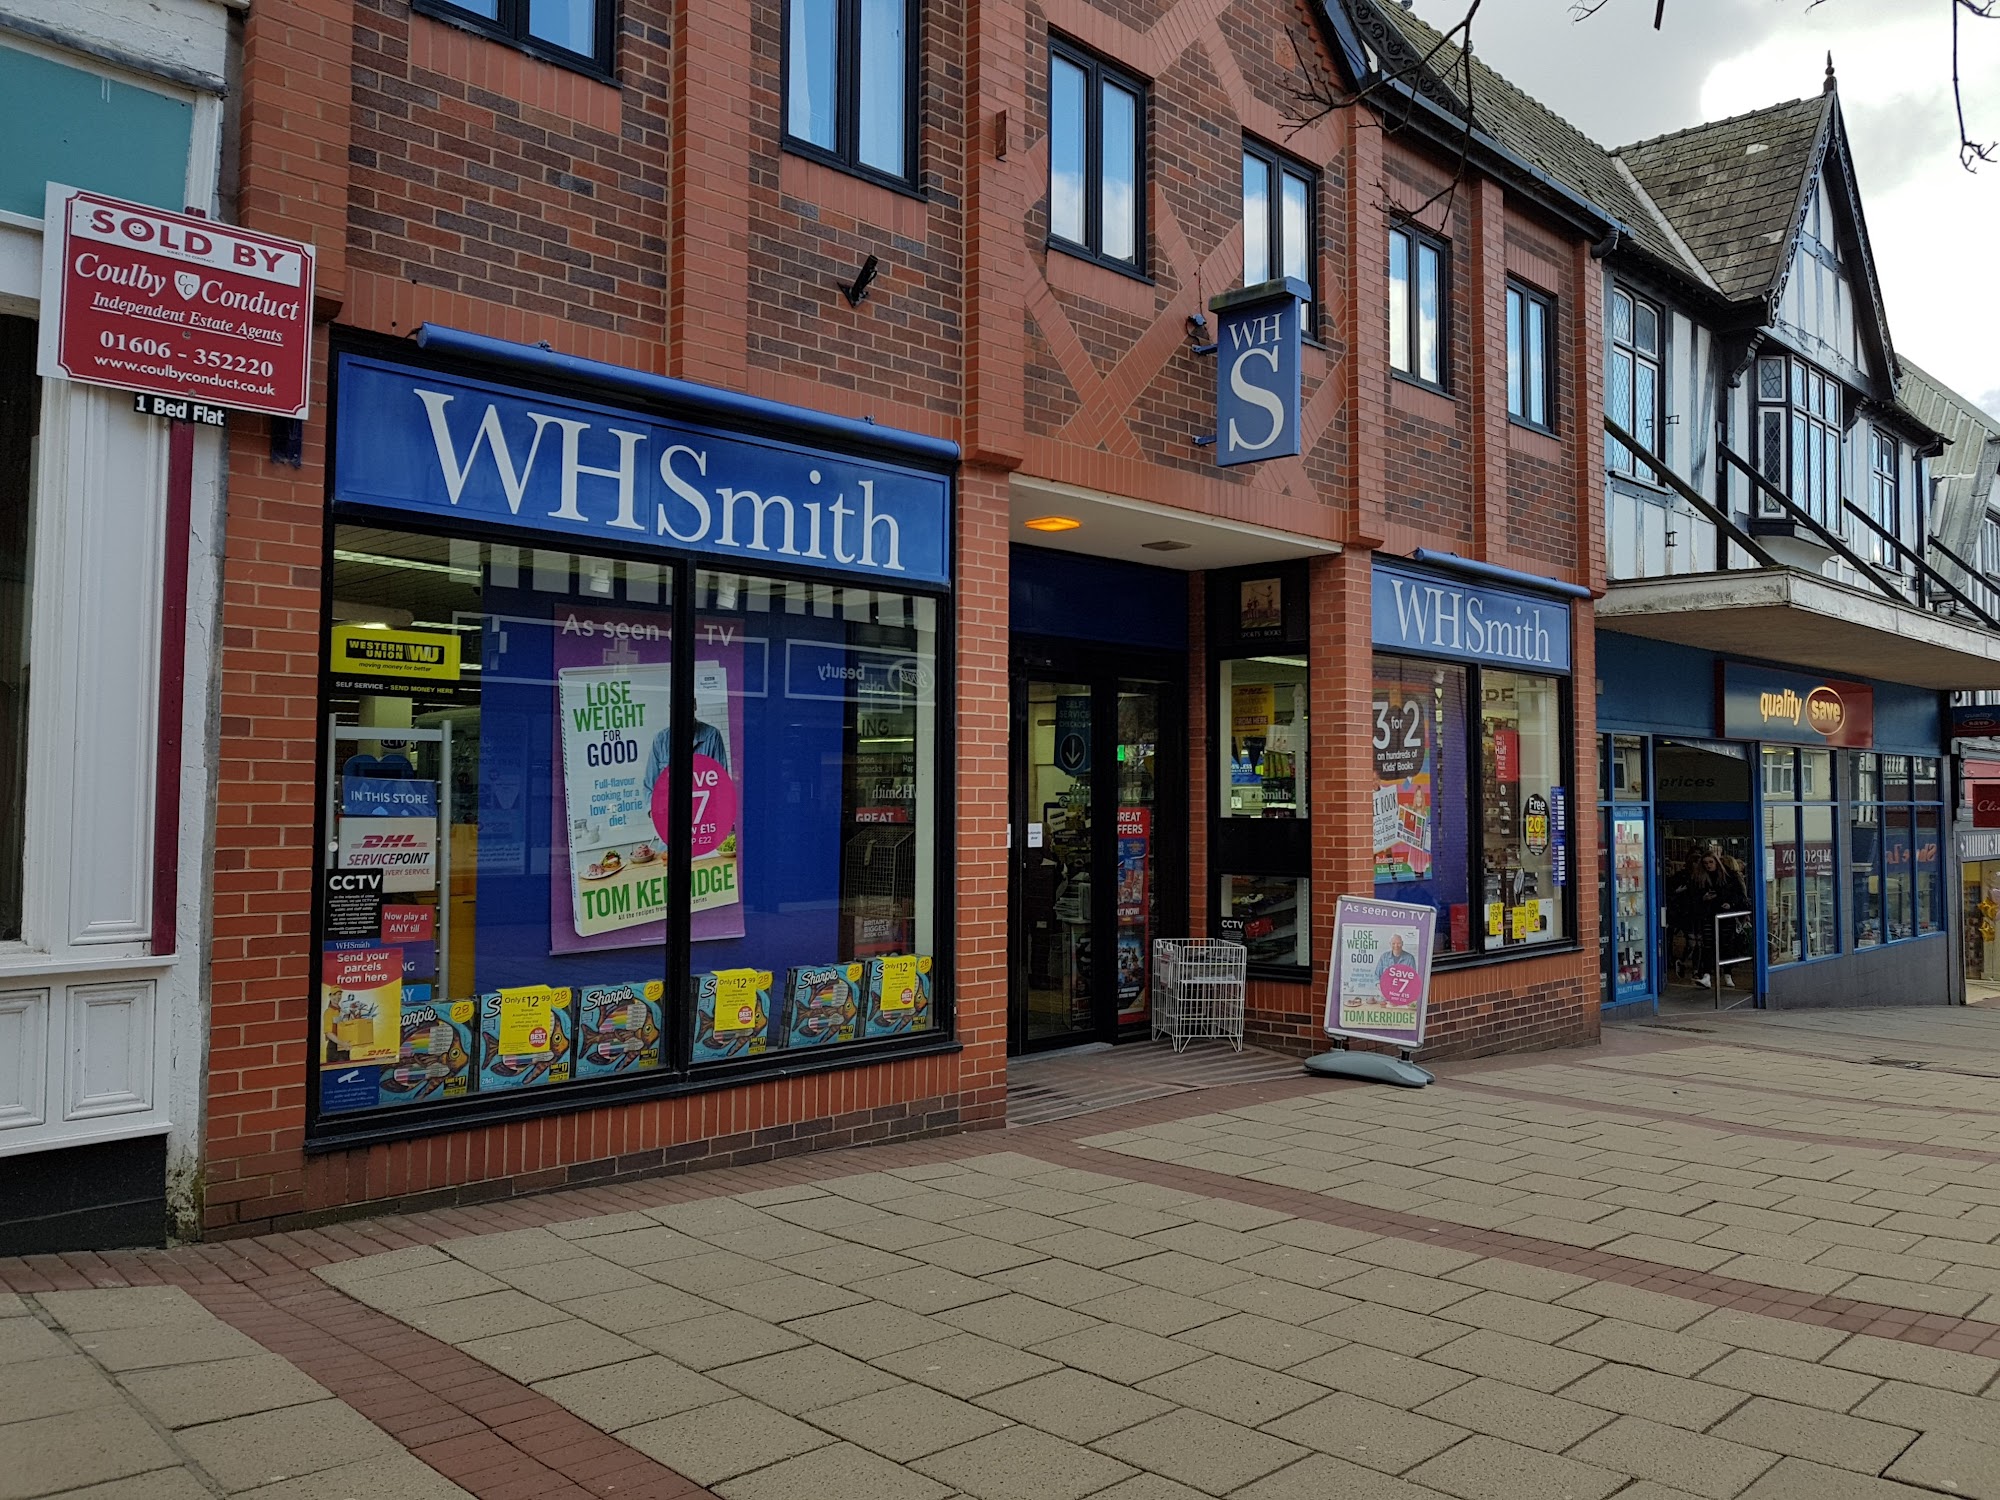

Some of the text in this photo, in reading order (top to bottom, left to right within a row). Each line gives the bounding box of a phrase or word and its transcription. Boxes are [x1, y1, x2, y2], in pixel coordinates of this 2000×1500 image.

[91, 209, 285, 273] SOLD BY
[74, 252, 300, 320] Coulby Conduct
[93, 291, 283, 342] Independent Estate Agents
[1228, 312, 1284, 351] WH
[100, 330, 171, 359] 01606
[193, 348, 274, 378] 352220
[94, 355, 275, 396] www.coulbyconduct.co.uk
[1228, 344, 1284, 452] S
[136, 395, 225, 426] 1 Bed Flat
[413, 388, 905, 571] WHSmith
[1390, 579, 1552, 664] WHSmith
[562, 614, 594, 637] As
[603, 620, 660, 642] seen
[704, 624, 735, 646] TV
[1240, 630, 1261, 638] SPORTS
[349, 640, 404, 652] WESTERN
[366, 650, 404, 660] UNION
[354, 682, 384, 690] SERVICE
[586, 680, 632, 707] LOSE
[1760, 688, 1841, 726] quality save
[572, 703, 646, 732] WEIGHT
[1059, 710, 1090, 719] SERVICE
[1372, 700, 1422, 750] 3 for 2
[603, 730, 621, 742] FOR
[587, 739, 638, 768] GOOD
[1377, 748, 1418, 761] on hundreds of
[1382, 760, 1414, 772] Kids' Books
[594, 778, 636, 789] Full-flavour
[1659, 776, 1716, 790] prices
[350, 790, 428, 804] IN THIS STORE
[592, 790, 621, 803] cooking
[623, 788, 634, 798] for
[590, 800, 643, 816] low-calorie
[1528, 798, 1546, 811] Free
[608, 814, 627, 827] diet
[700, 823, 716, 834] £15
[362, 834, 417, 848] DHL
[347, 852, 430, 866] SERVICEPOINT
[328, 874, 381, 891] CCTV
[582, 884, 631, 920] TOM
[384, 912, 402, 920] Now
[403, 912, 418, 922] play
[626, 912, 635, 920] the
[635, 909, 655, 919] recipes
[1344, 902, 1426, 922] As seen on TV
[390, 924, 420, 933] ANY till
[1222, 920, 1244, 929] CCTV
[1352, 930, 1374, 941] LOSE
[335, 942, 370, 950] WHSmith
[1346, 939, 1379, 950] WEIGHT
[336, 952, 390, 963] Send your
[920, 959, 930, 968] 28
[1350, 953, 1374, 964] GOOD
[344, 962, 382, 974] parcels
[850, 966, 860, 976] 28
[884, 962, 897, 971] Only
[1388, 966, 1415, 980] Save
[336, 972, 388, 984] from here
[718, 978, 733, 986] Only
[757, 974, 770, 986] 28
[798, 968, 838, 990] Sharpie
[647, 984, 660, 995] 28
[1392, 978, 1410, 994] £7
[504, 996, 522, 1006] Only
[554, 991, 568, 1003] 28
[583, 986, 634, 1012] Sharpie
[454, 1004, 470, 1018] 28
[1344, 1010, 1364, 1022] TOM
[1366, 1010, 1416, 1025] KERRIDGE
